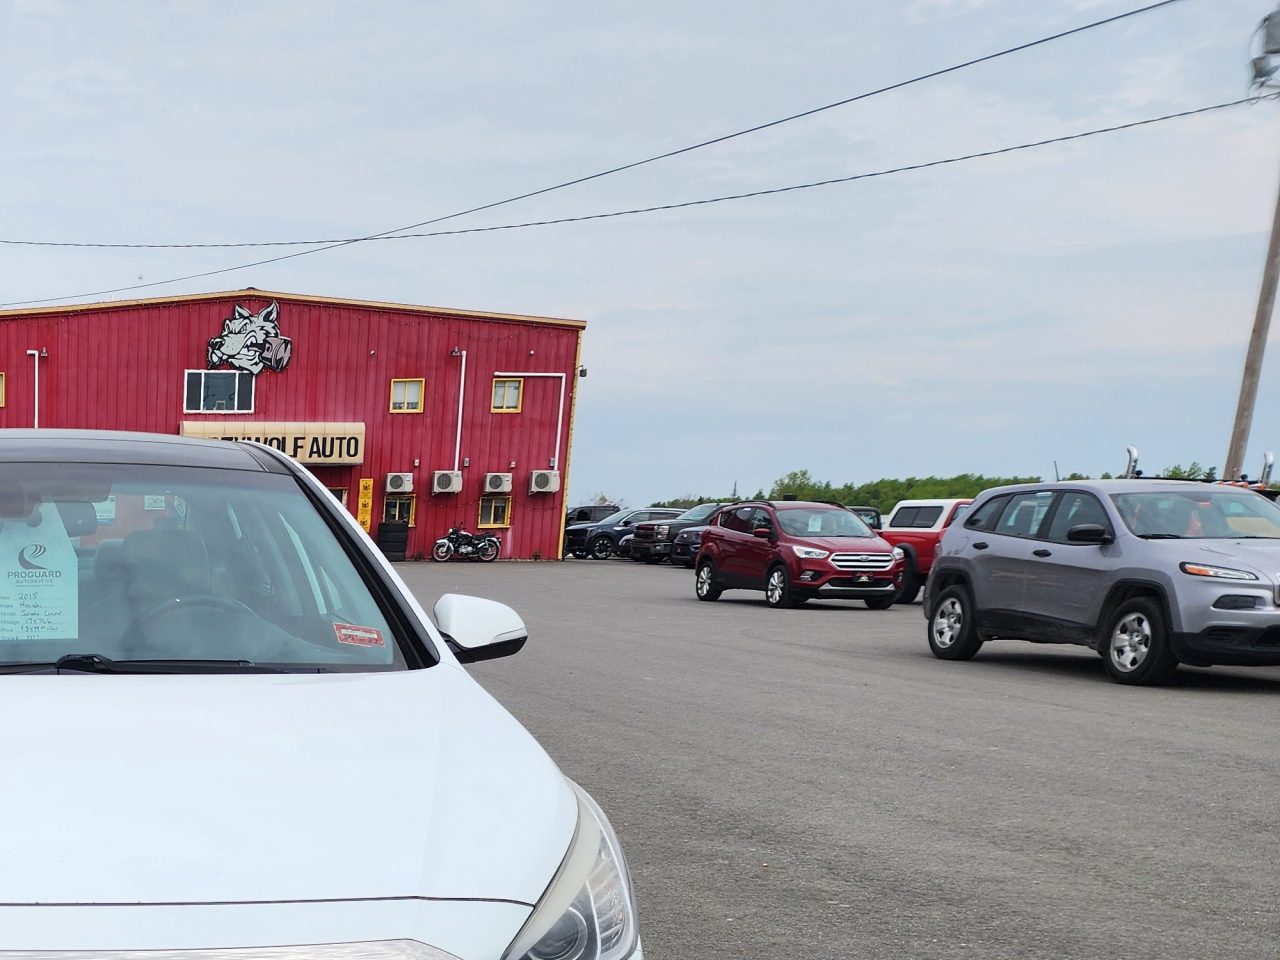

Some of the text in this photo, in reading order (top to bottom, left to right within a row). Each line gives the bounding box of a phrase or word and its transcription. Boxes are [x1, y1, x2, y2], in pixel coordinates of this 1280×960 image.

[308, 436, 359, 458] AUTO
[7, 570, 62, 579] PROGUARD
[18, 592, 40, 600] 2015
